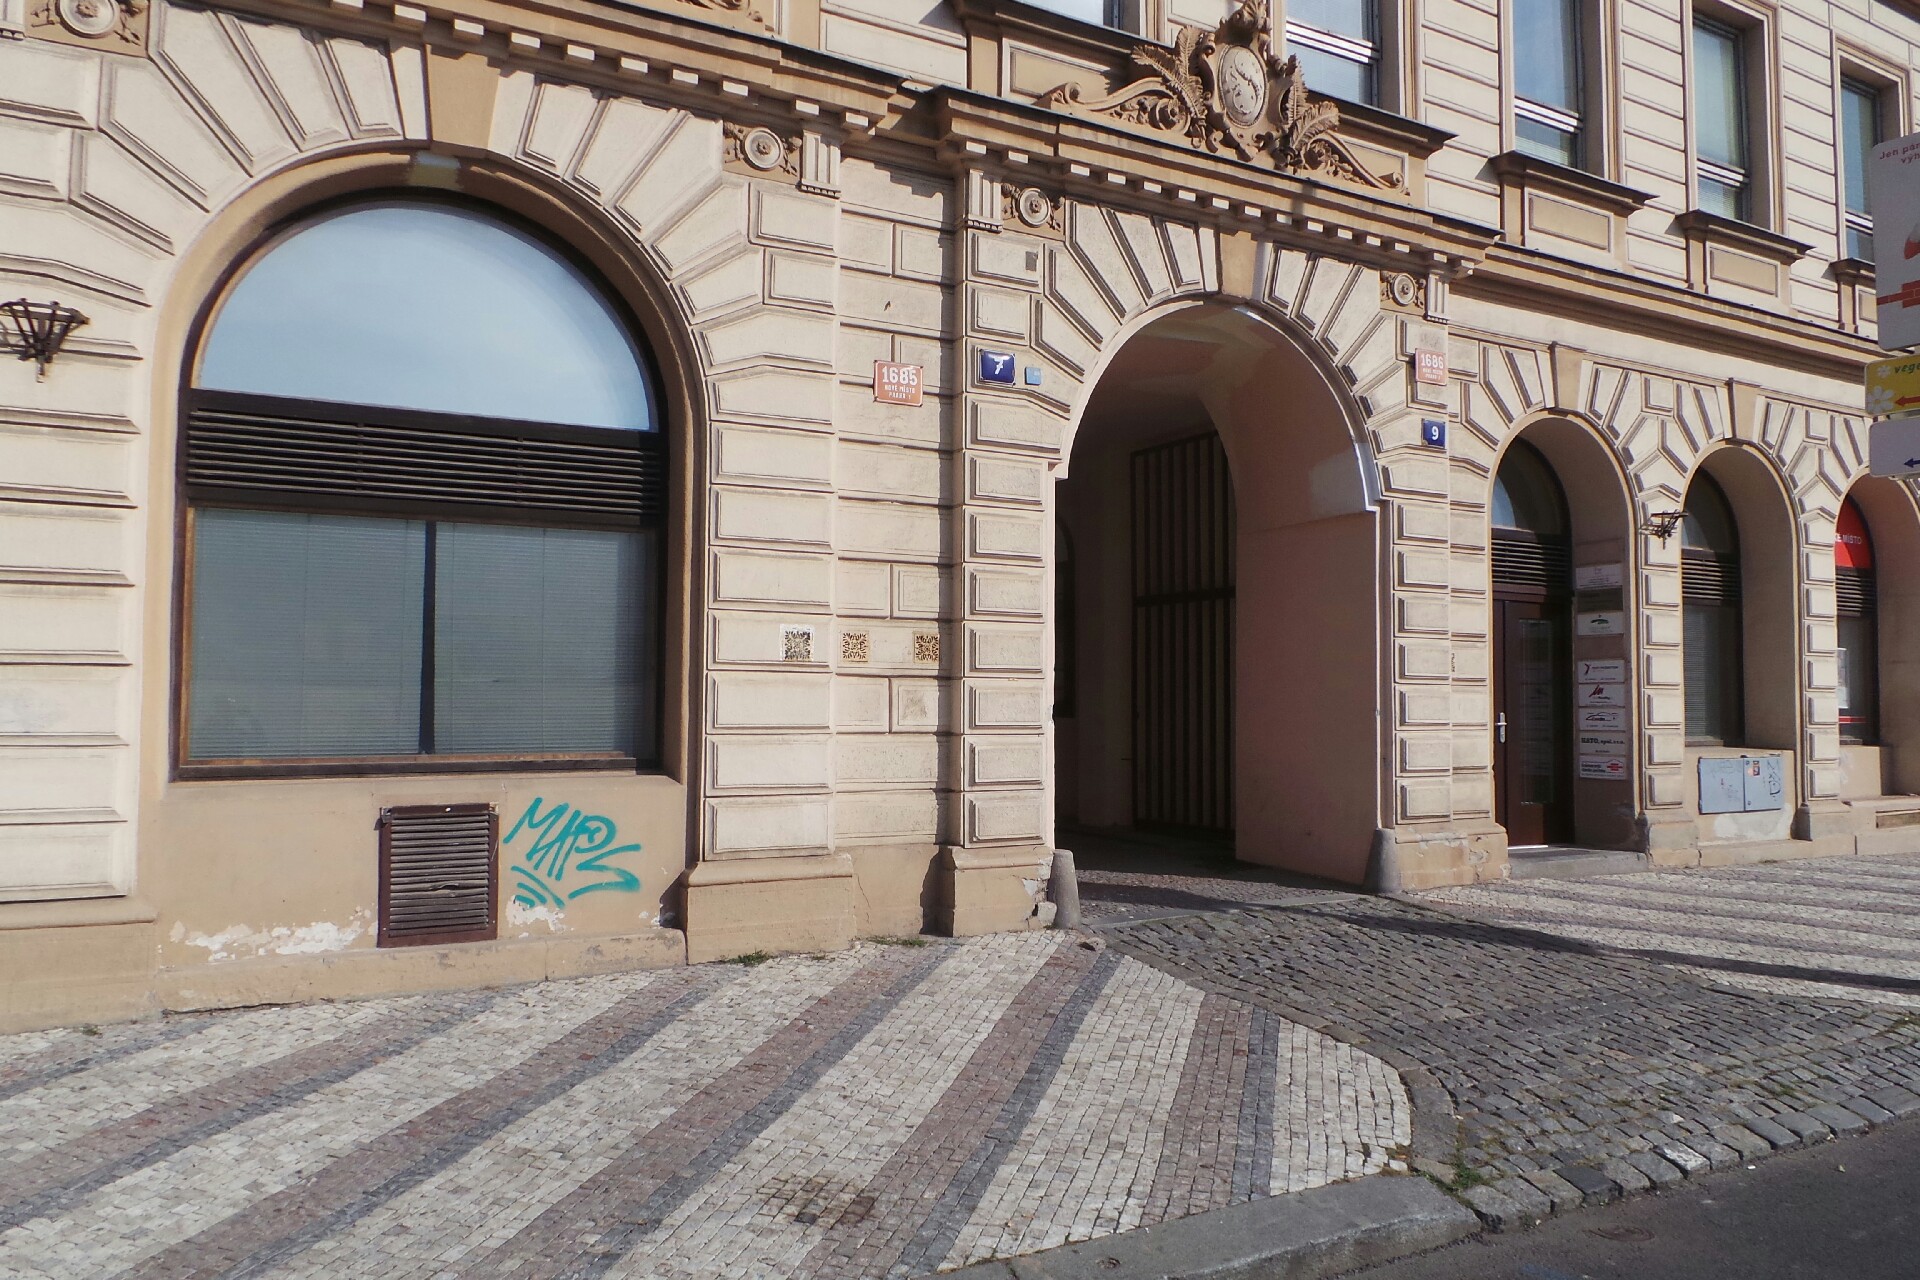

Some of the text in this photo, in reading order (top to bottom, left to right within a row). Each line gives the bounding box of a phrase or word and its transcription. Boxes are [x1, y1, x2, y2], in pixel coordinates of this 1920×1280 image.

[1879, 149, 1899, 160] Jen
[994, 355, 1004, 375] 7
[1421, 354, 1443, 369] 1686
[882, 366, 918, 386] 1685
[1432, 426, 1439, 440] 9
